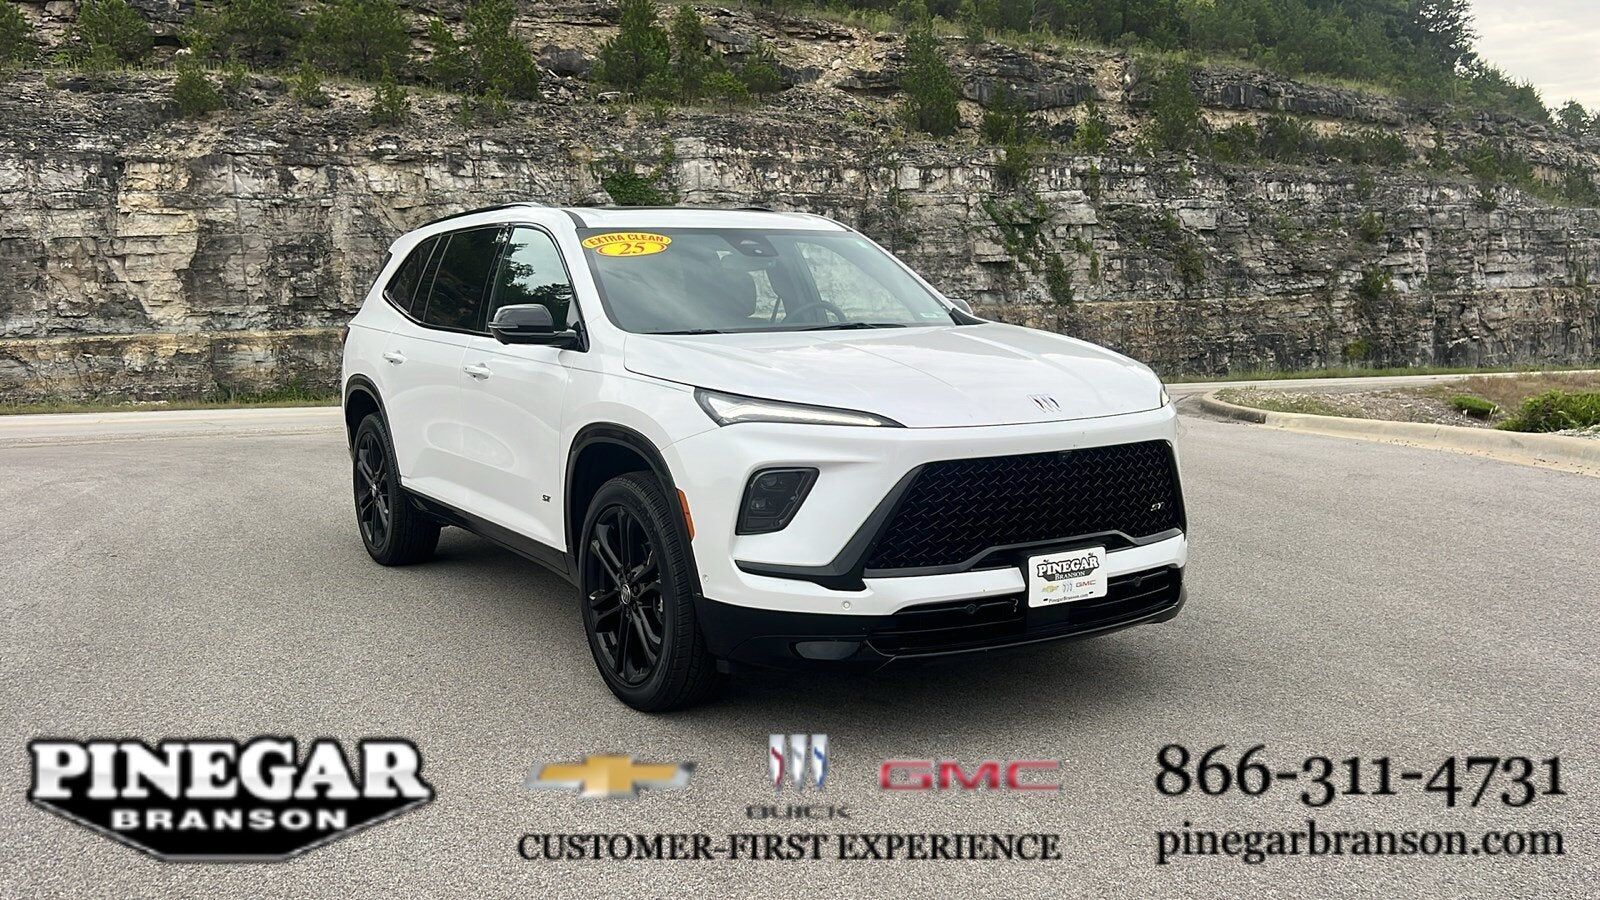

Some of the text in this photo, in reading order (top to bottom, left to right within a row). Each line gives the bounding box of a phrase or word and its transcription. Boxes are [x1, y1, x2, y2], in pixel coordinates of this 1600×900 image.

[588, 233, 664, 246] EXTRA CLEAN
[619, 242, 646, 255] 25
[1038, 556, 1099, 577] PINEGAR
[1075, 580, 1096, 588] GMC
